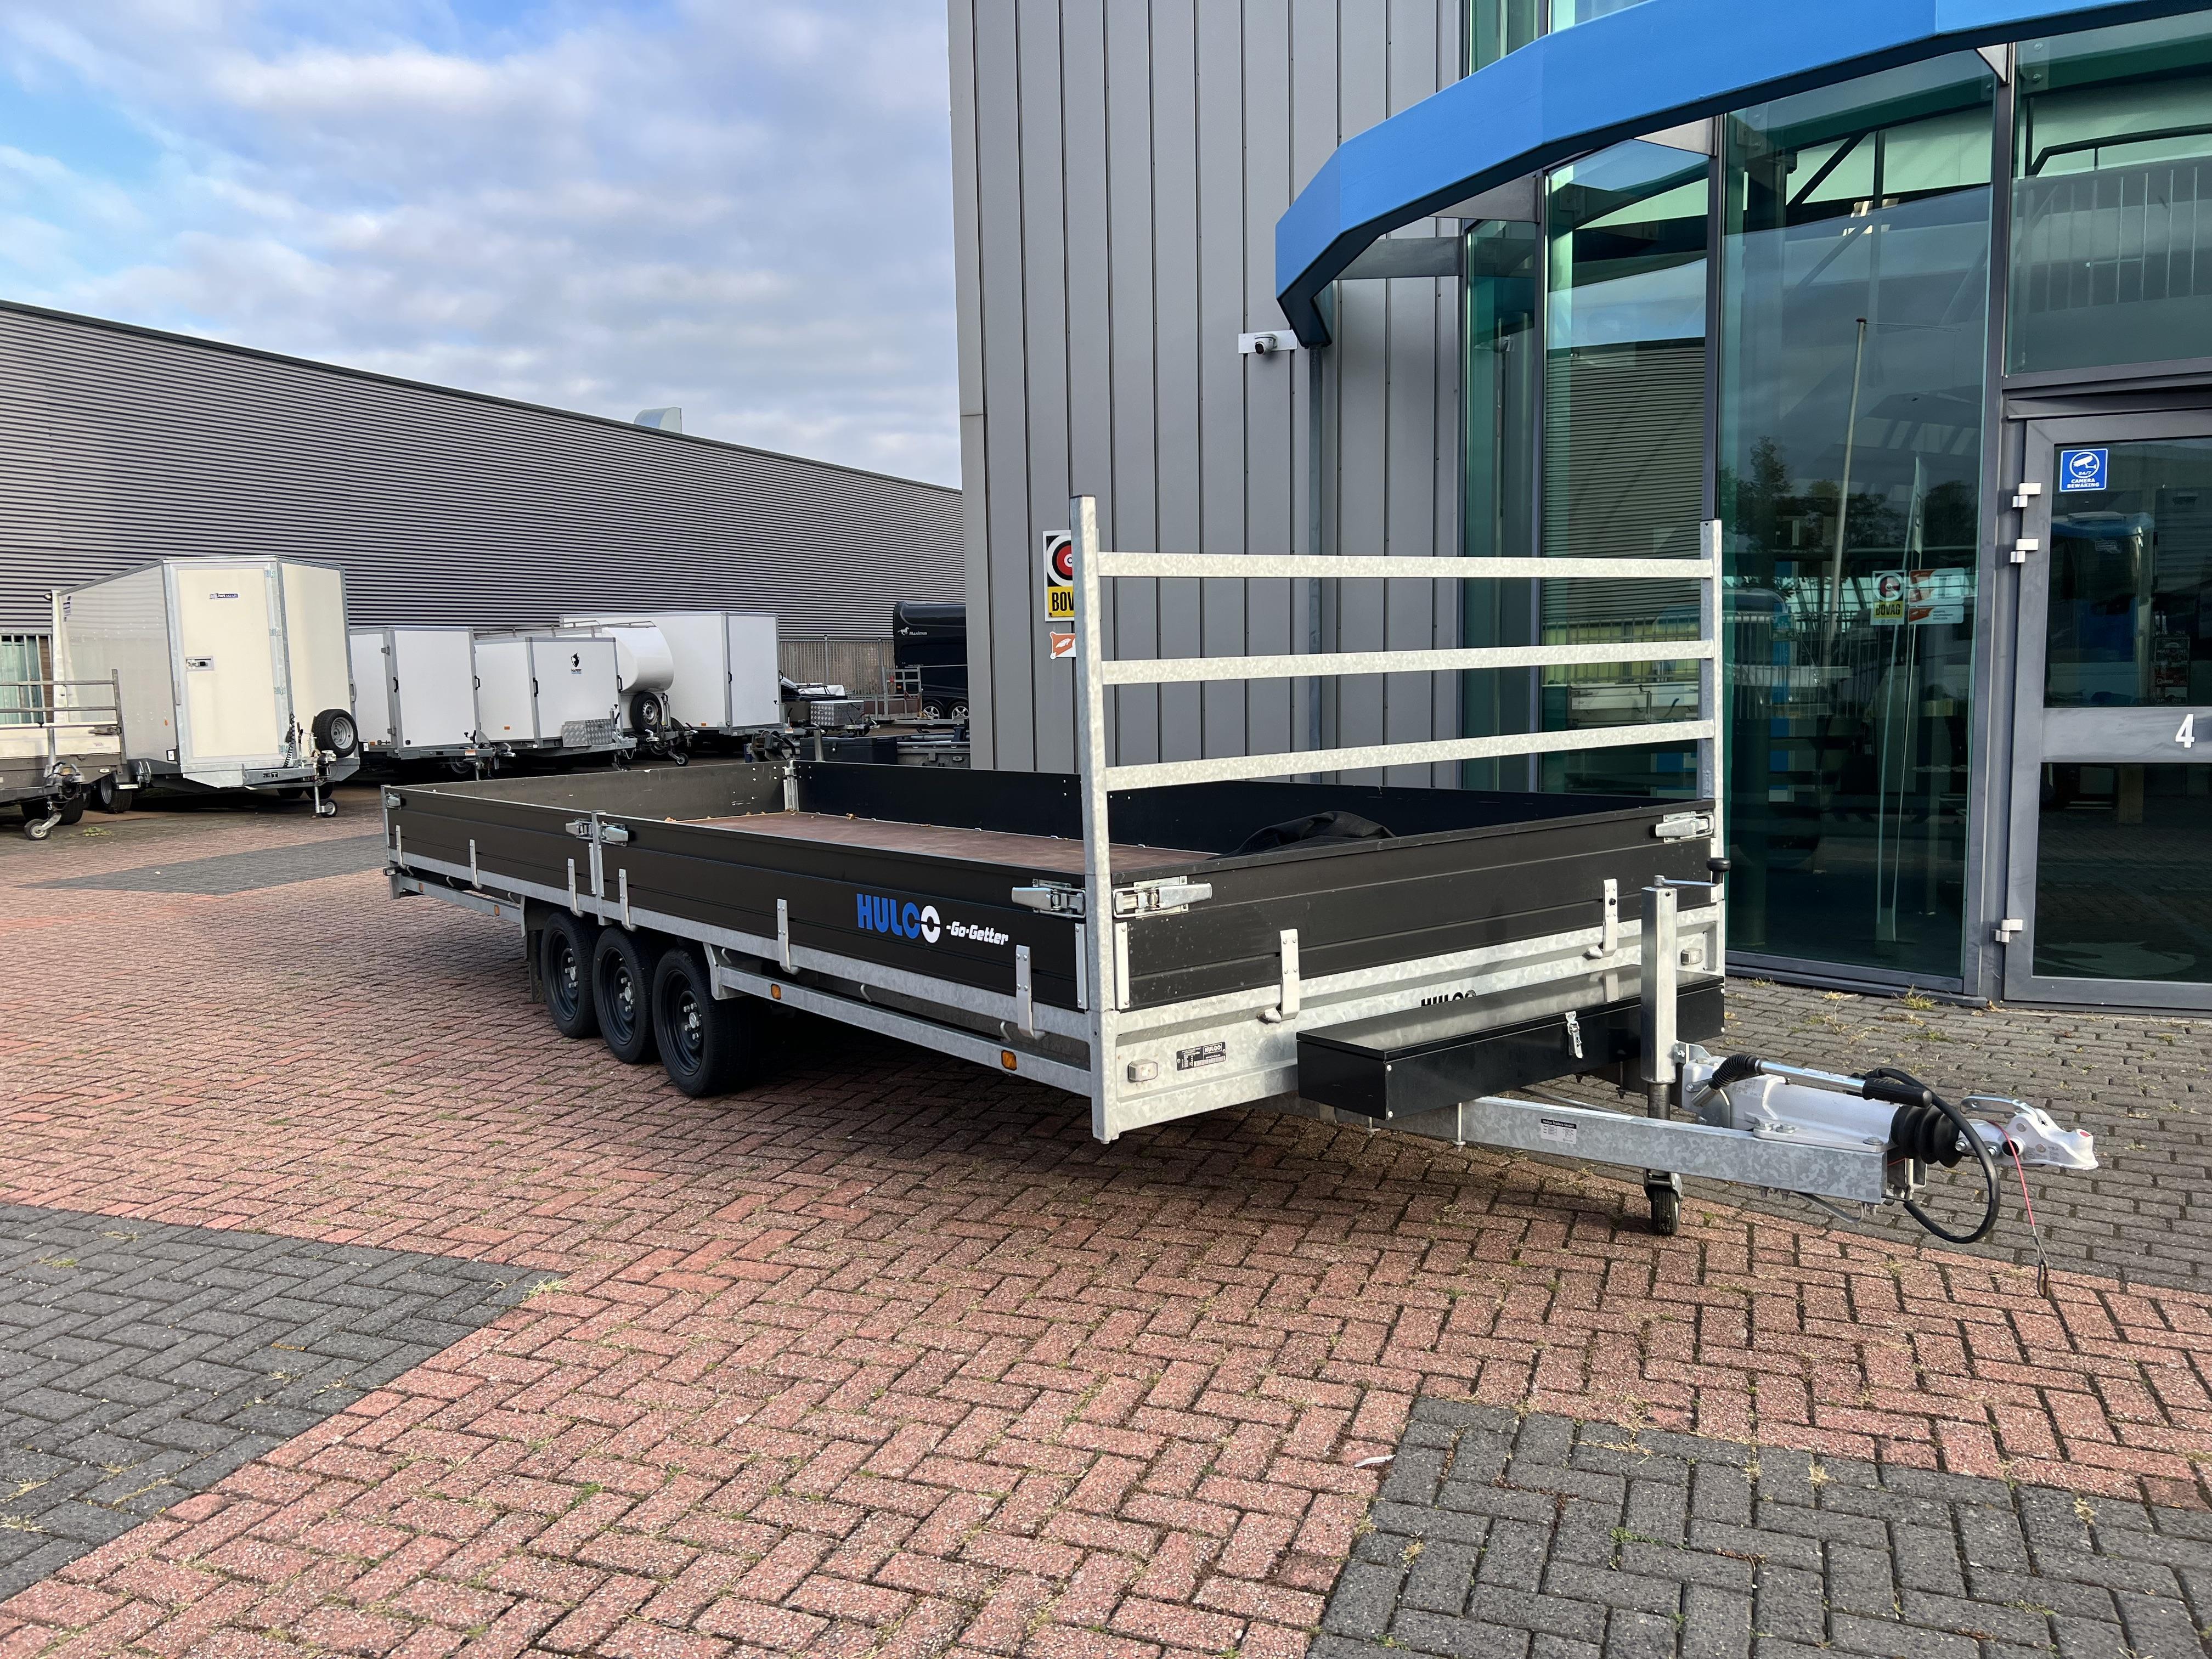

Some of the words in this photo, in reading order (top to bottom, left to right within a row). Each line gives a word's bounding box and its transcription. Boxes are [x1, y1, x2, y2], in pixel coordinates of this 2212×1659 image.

[1876, 604, 1900, 616] BOVAG
[2175, 714, 2194, 748] 4
[856, 894, 940, 943] HULCO
